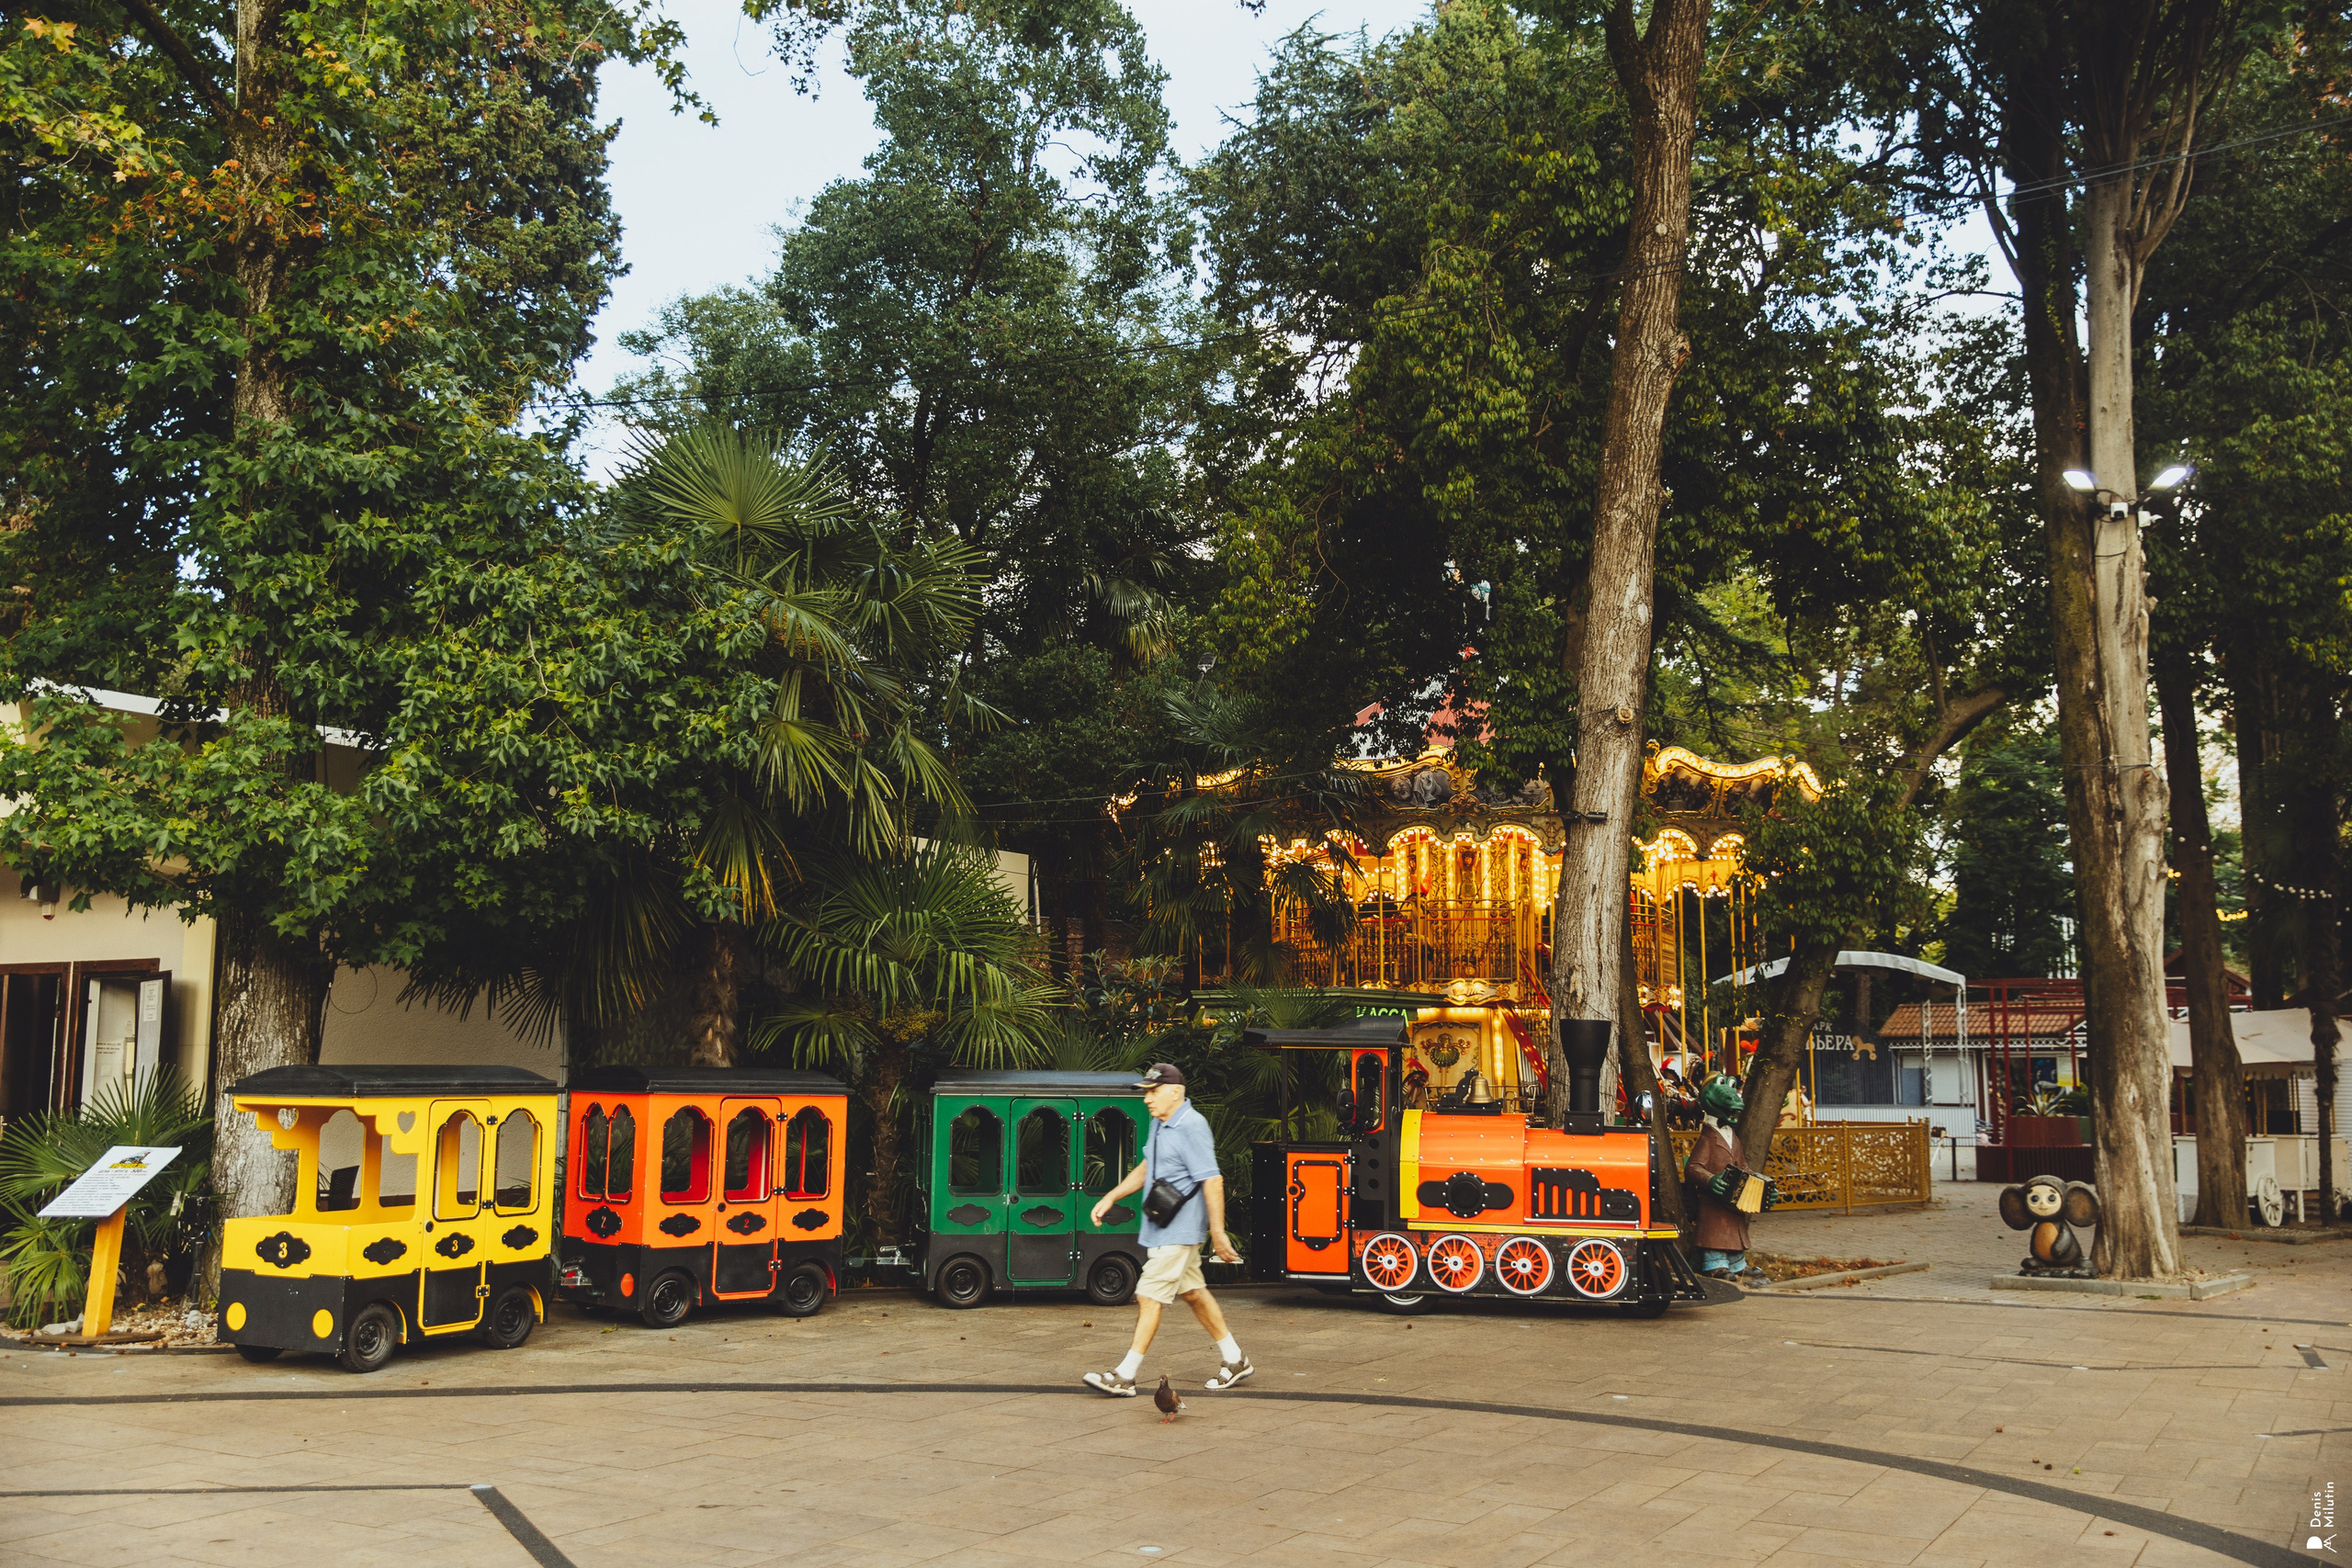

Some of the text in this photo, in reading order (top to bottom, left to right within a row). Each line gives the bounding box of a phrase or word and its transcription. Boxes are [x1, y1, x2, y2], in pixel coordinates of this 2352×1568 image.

[1812, 1021, 1833, 1032] АРК
[1804, 1034, 1855, 1051] ВЬЕРА
[277, 1241, 288, 1258] 3
[451, 1239, 459, 1252] 3
